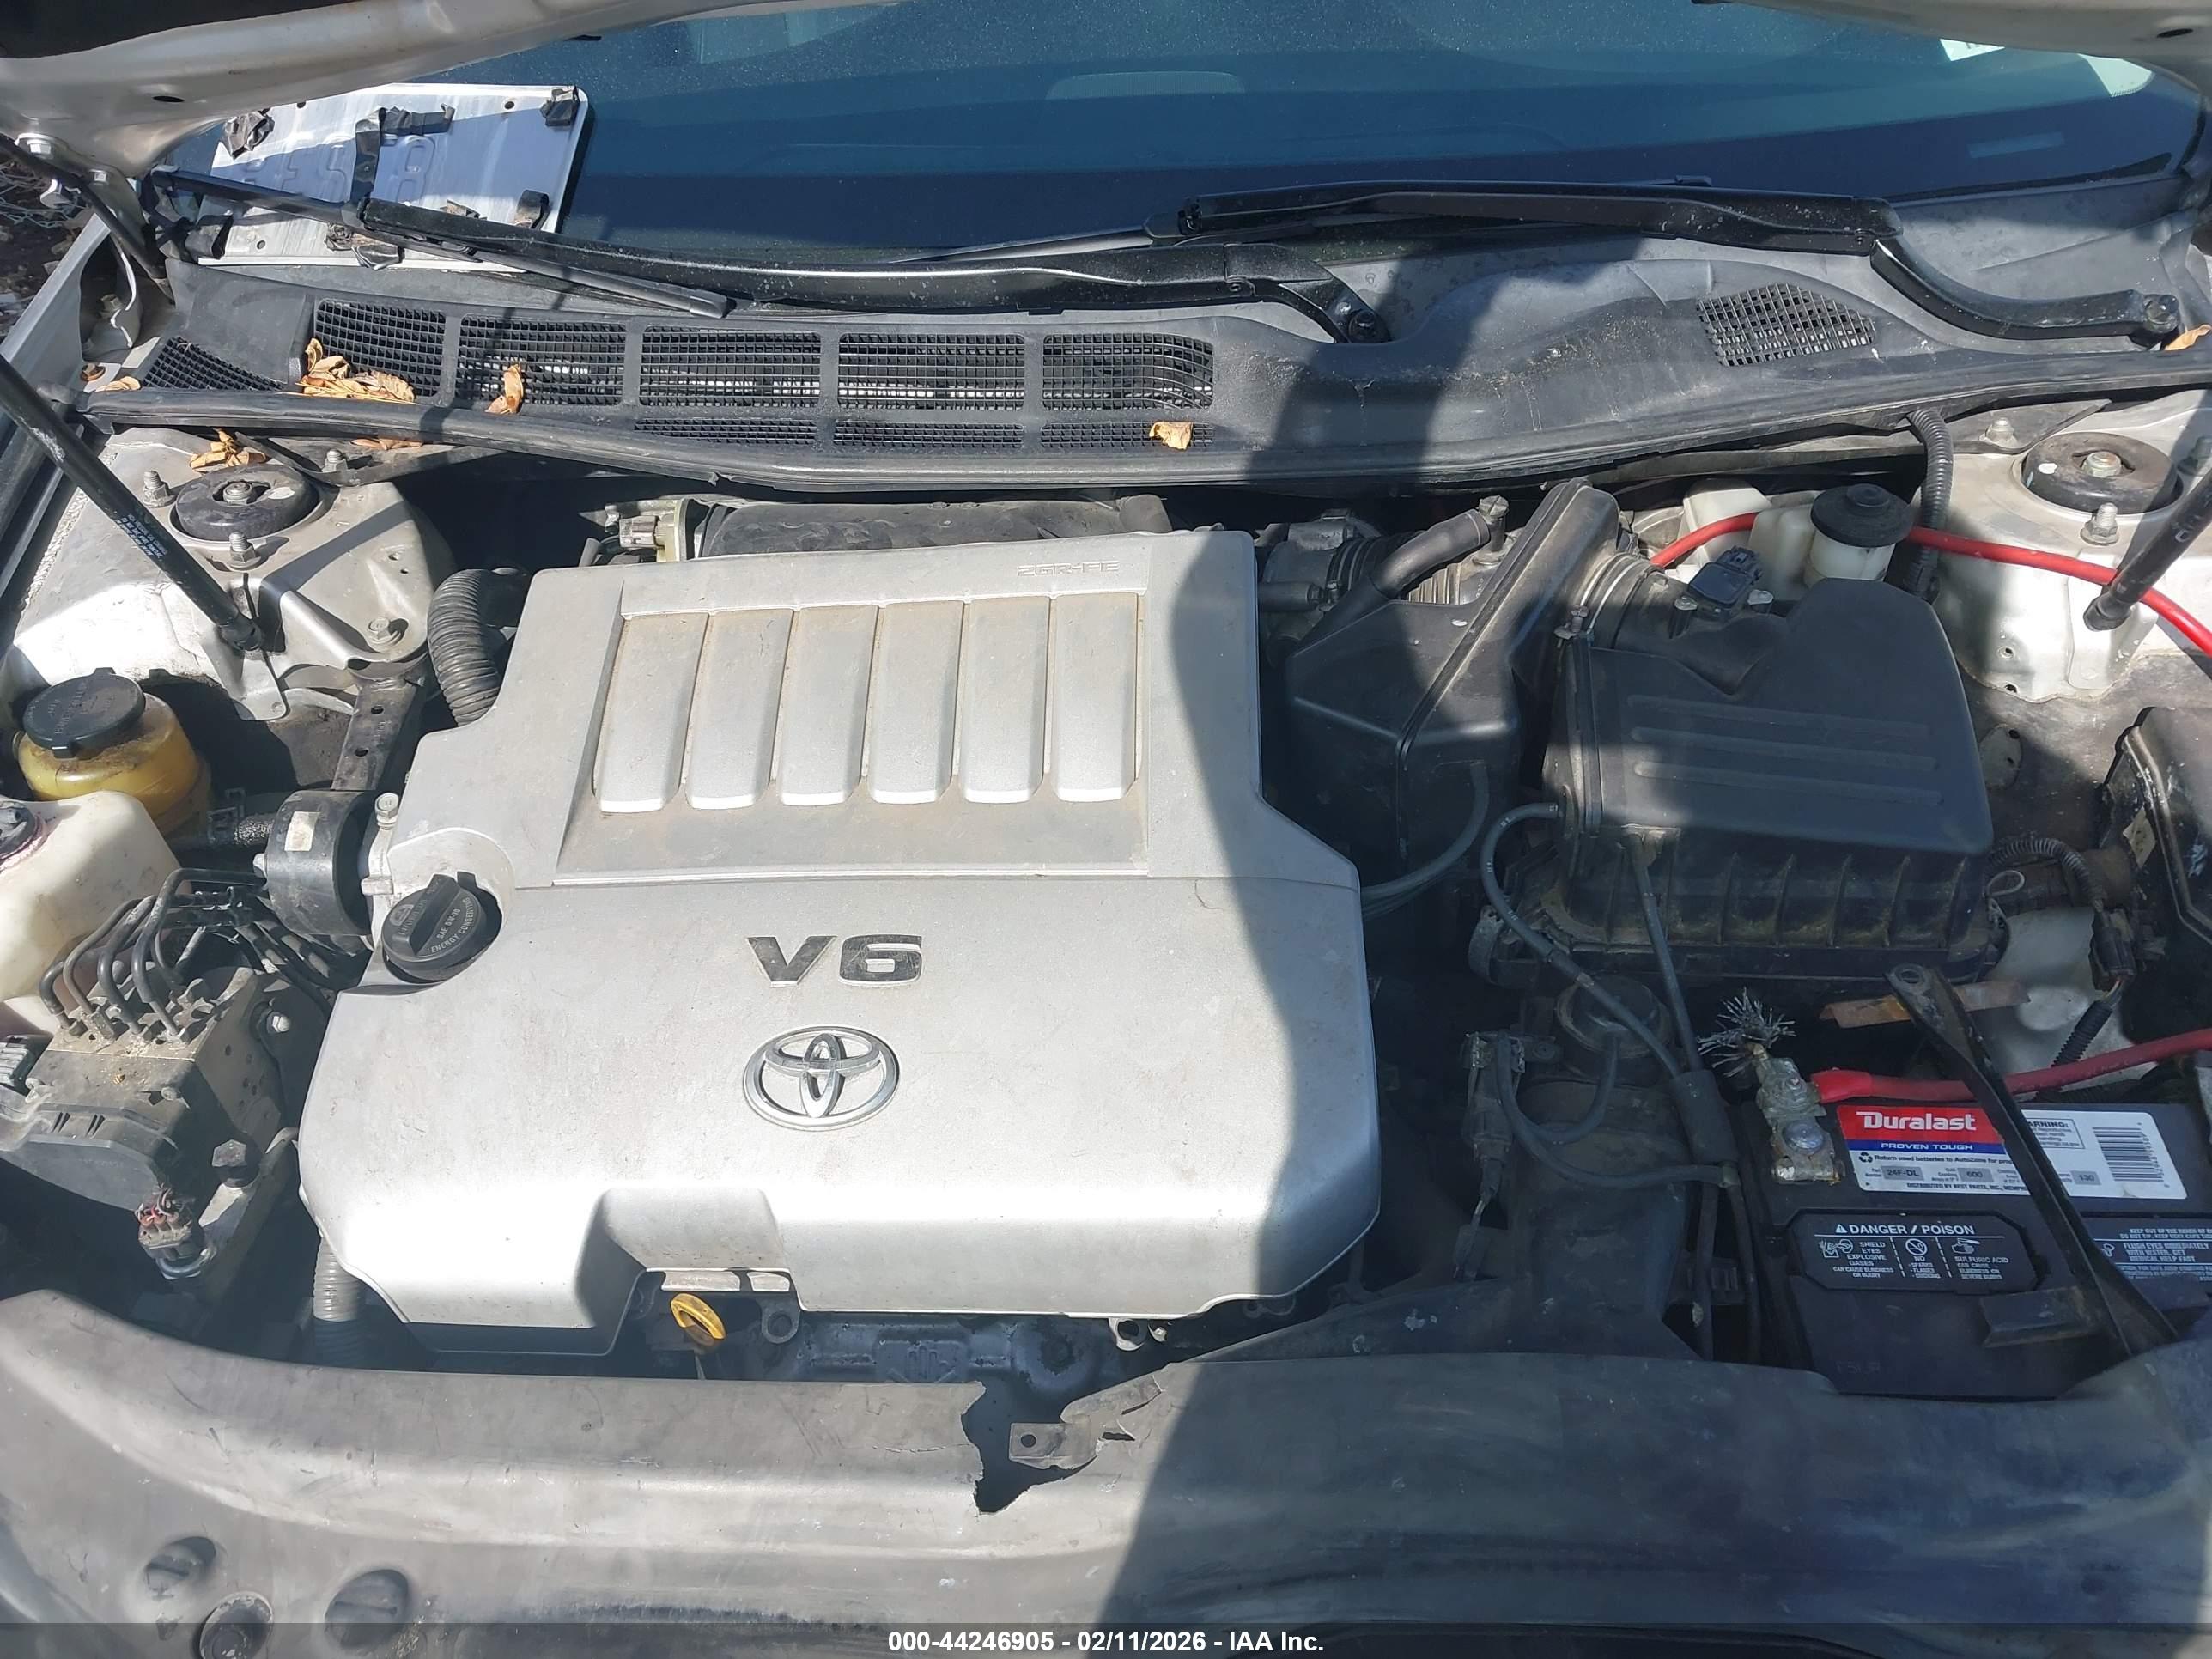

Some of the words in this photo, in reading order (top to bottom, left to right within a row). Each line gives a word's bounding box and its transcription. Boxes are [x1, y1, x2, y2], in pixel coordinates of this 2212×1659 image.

[431, 933, 459, 953] ENERGY
[436, 927, 448, 939] SAE
[745, 933, 923, 988] V6
[1856, 1111, 1977, 1131] Duralast
[1849, 1224, 1907, 1234] DANGER
[1911, 1225, 1917, 1234] /
[1922, 1225, 1975, 1235] POISON
